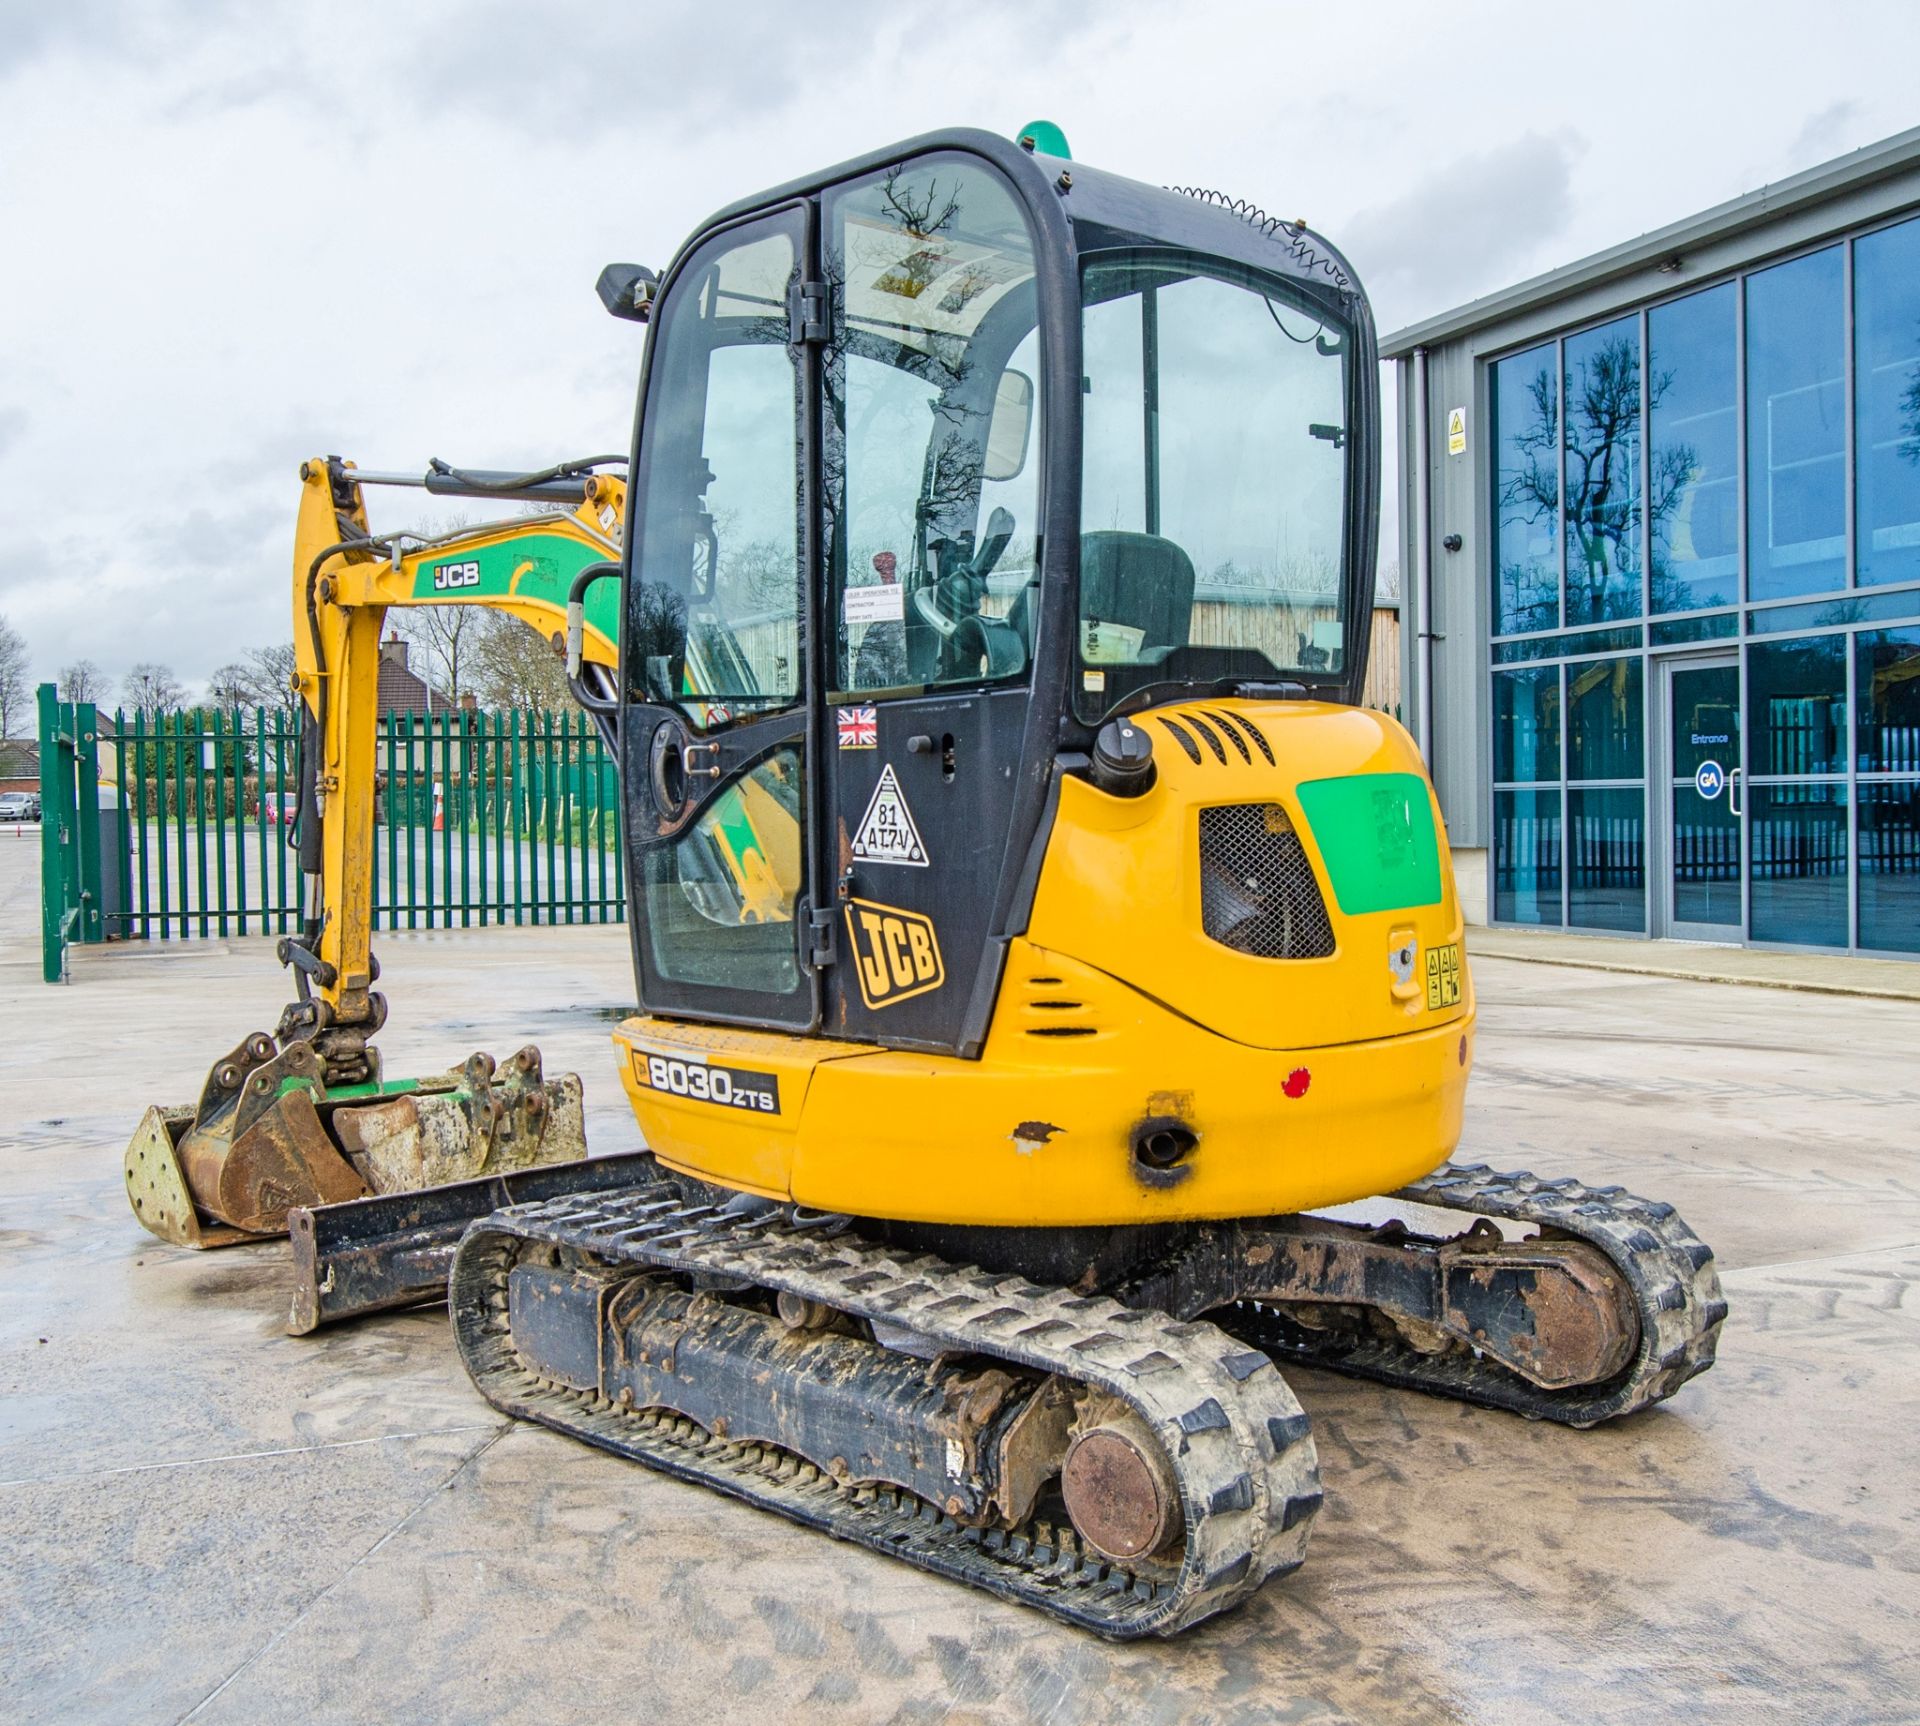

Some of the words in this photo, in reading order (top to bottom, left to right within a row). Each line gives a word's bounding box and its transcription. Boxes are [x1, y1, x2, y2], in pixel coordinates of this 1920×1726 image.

[435, 561, 479, 589] JCB
[1691, 733, 1729, 745] Entrance
[879, 804, 898, 827] 81
[859, 910, 936, 997] JCB
